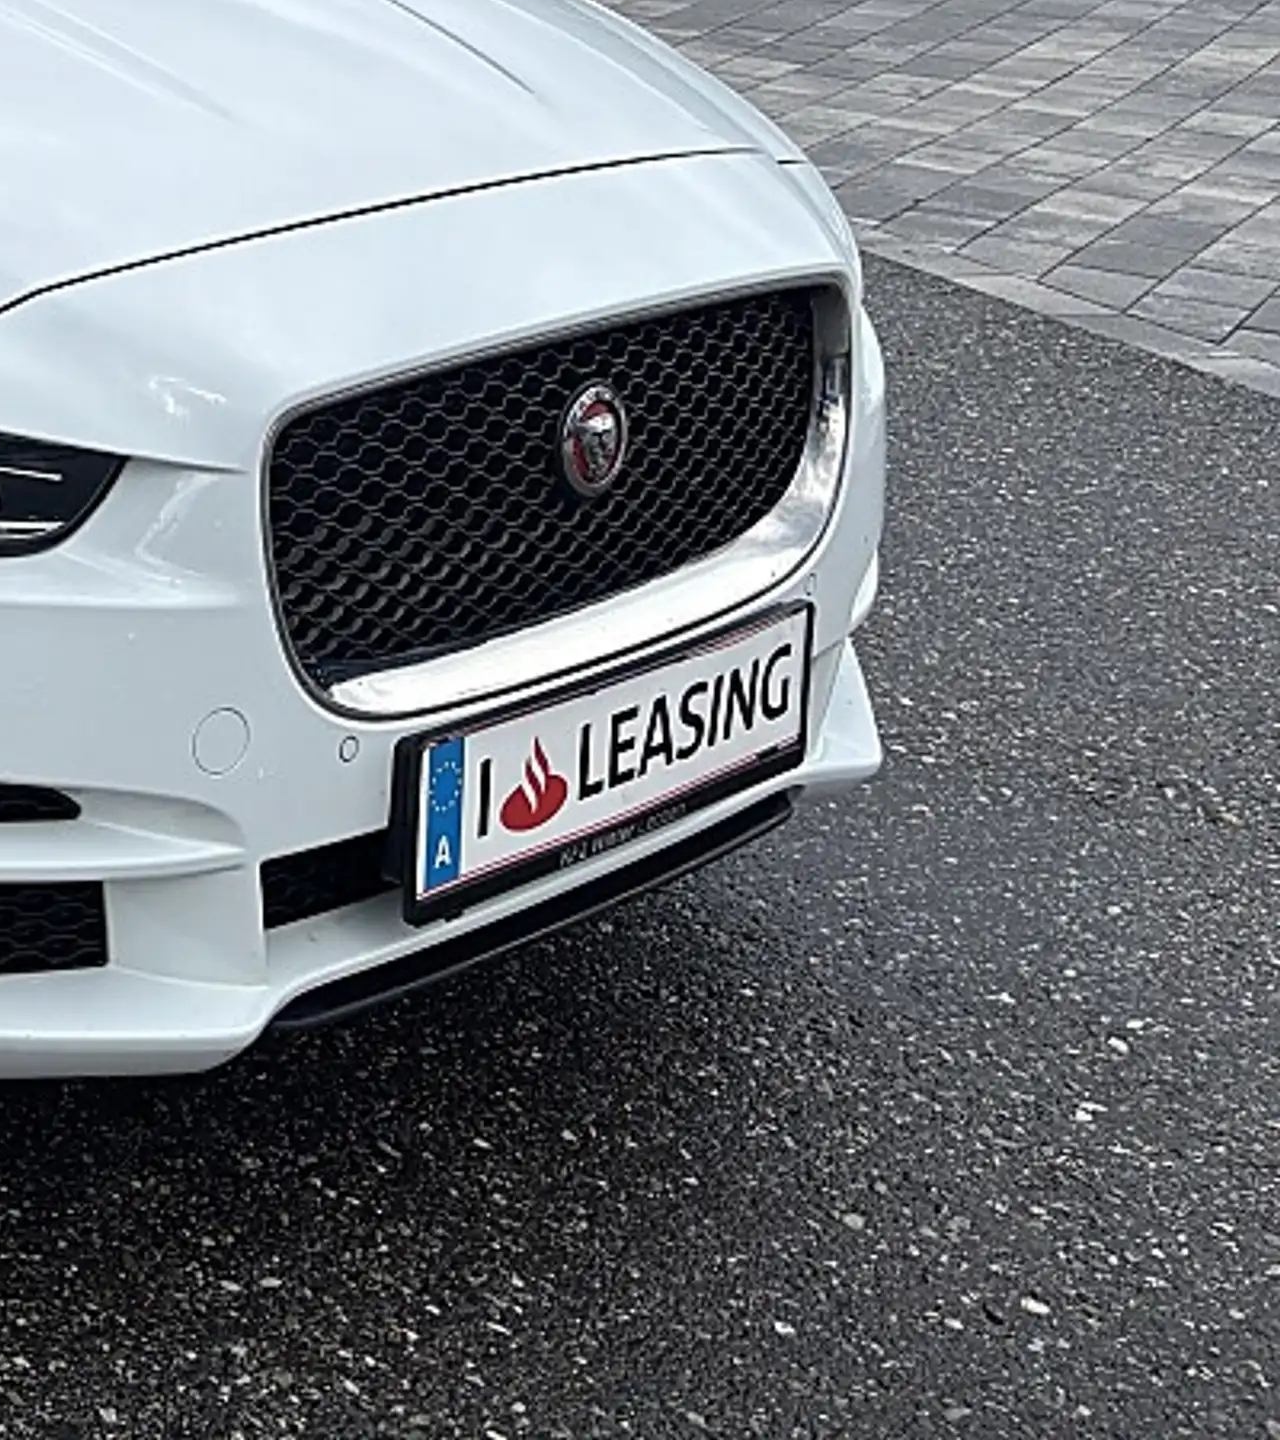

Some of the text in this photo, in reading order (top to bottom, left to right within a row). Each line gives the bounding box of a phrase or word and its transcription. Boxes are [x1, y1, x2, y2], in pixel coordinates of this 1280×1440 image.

[476, 758, 492, 838] I
[577, 643, 793, 801] LEASING
[434, 835, 453, 868] A
